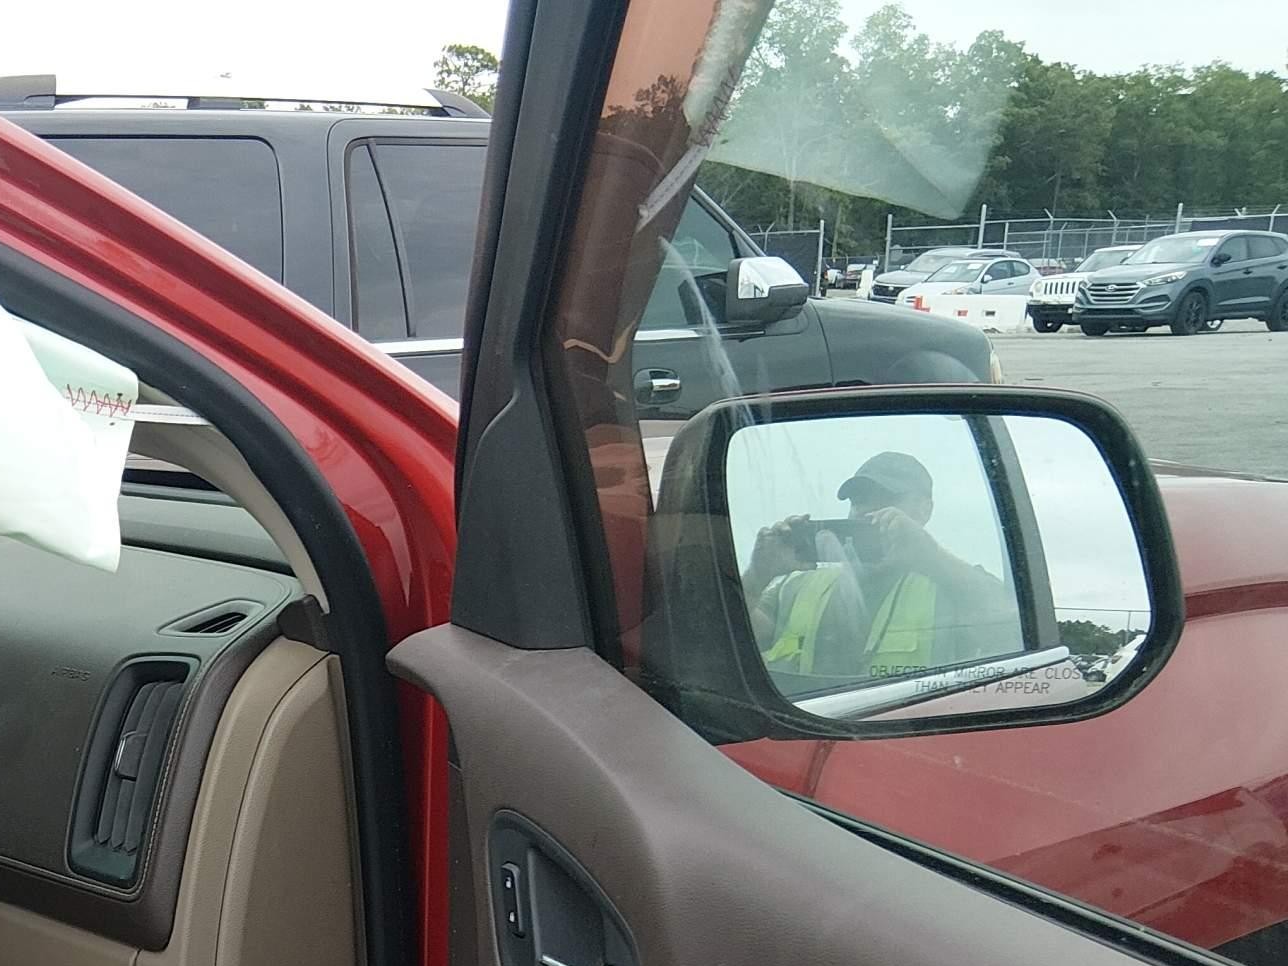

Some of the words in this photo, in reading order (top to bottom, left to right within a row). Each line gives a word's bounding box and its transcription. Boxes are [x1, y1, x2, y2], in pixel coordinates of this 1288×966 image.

[870, 665, 927, 679] OBJECTS
[954, 666, 1005, 680] MIRROR
[914, 681, 949, 693] THAN
[955, 682, 987, 693] TEY
[995, 681, 1051, 695] APPEAR
